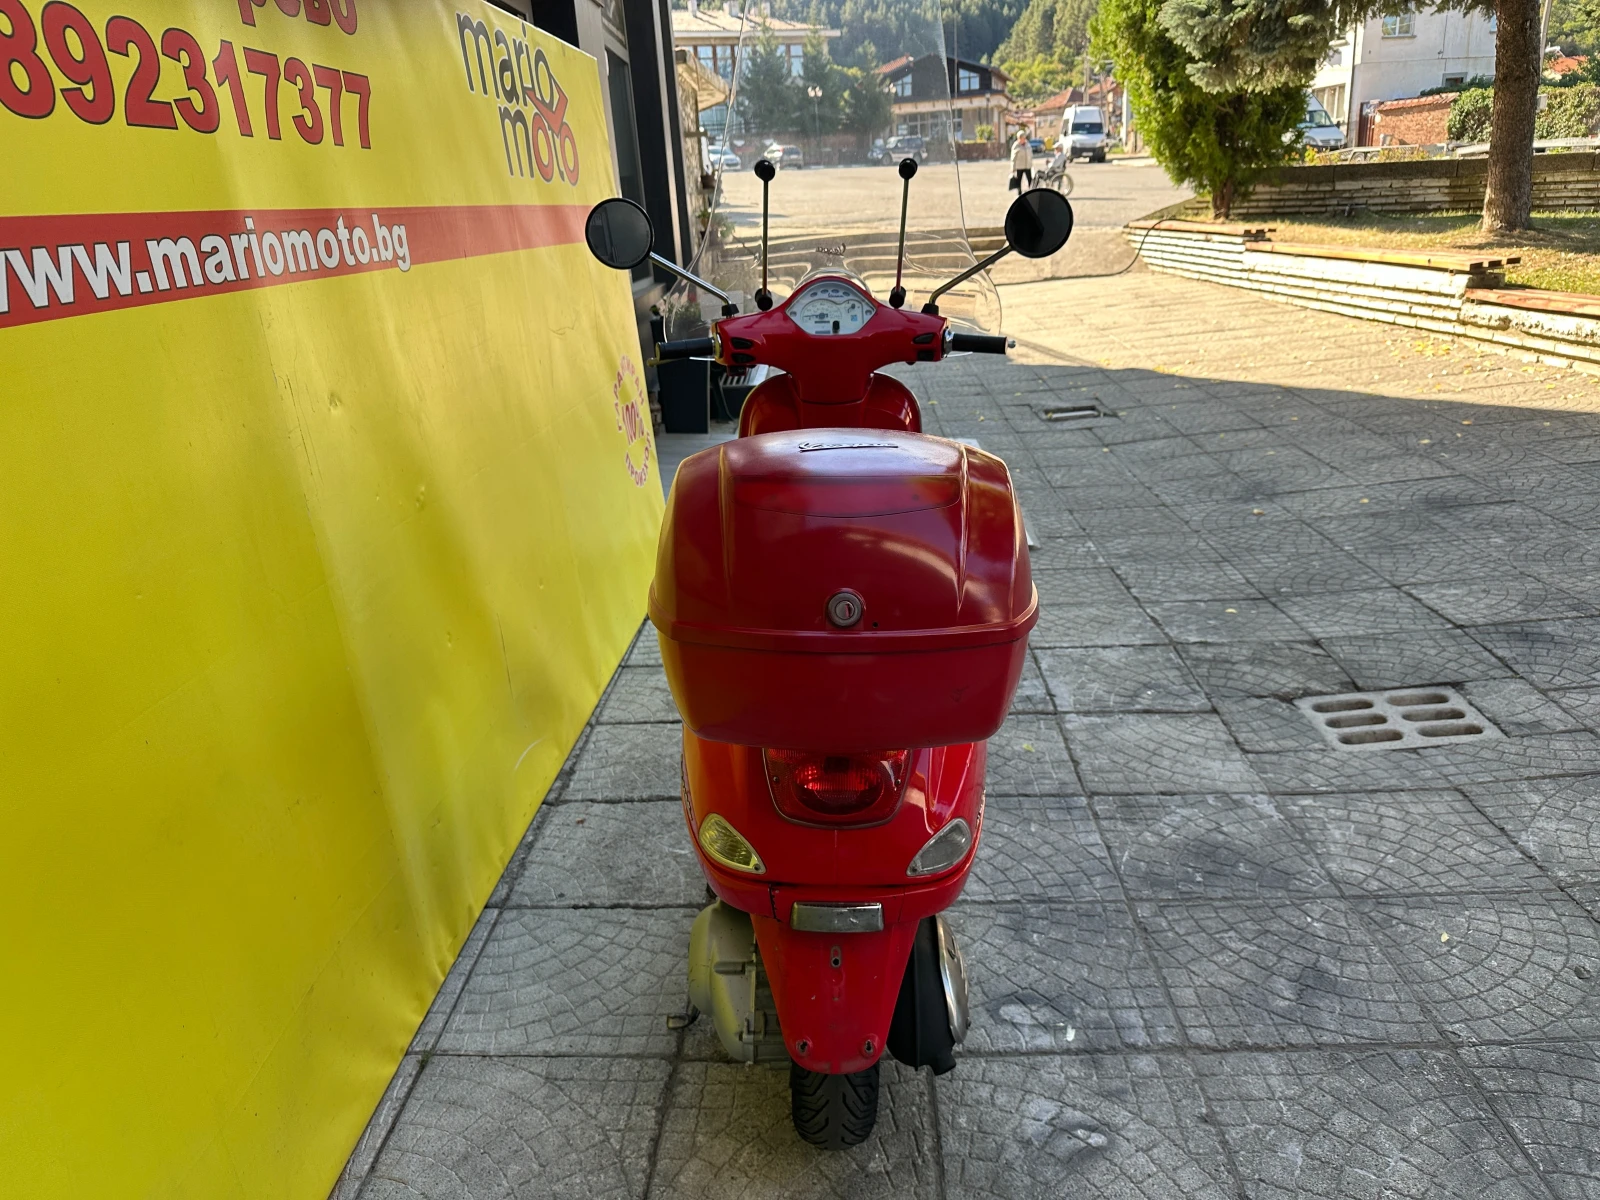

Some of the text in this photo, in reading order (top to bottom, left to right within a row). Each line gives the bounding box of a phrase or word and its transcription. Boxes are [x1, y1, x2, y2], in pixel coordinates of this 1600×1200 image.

[0, 0, 371, 149] 892317377
[456, 12, 554, 110] mario
[498, 106, 579, 186] moto
[0, 213, 411, 314] ww.mariomoto.bg
